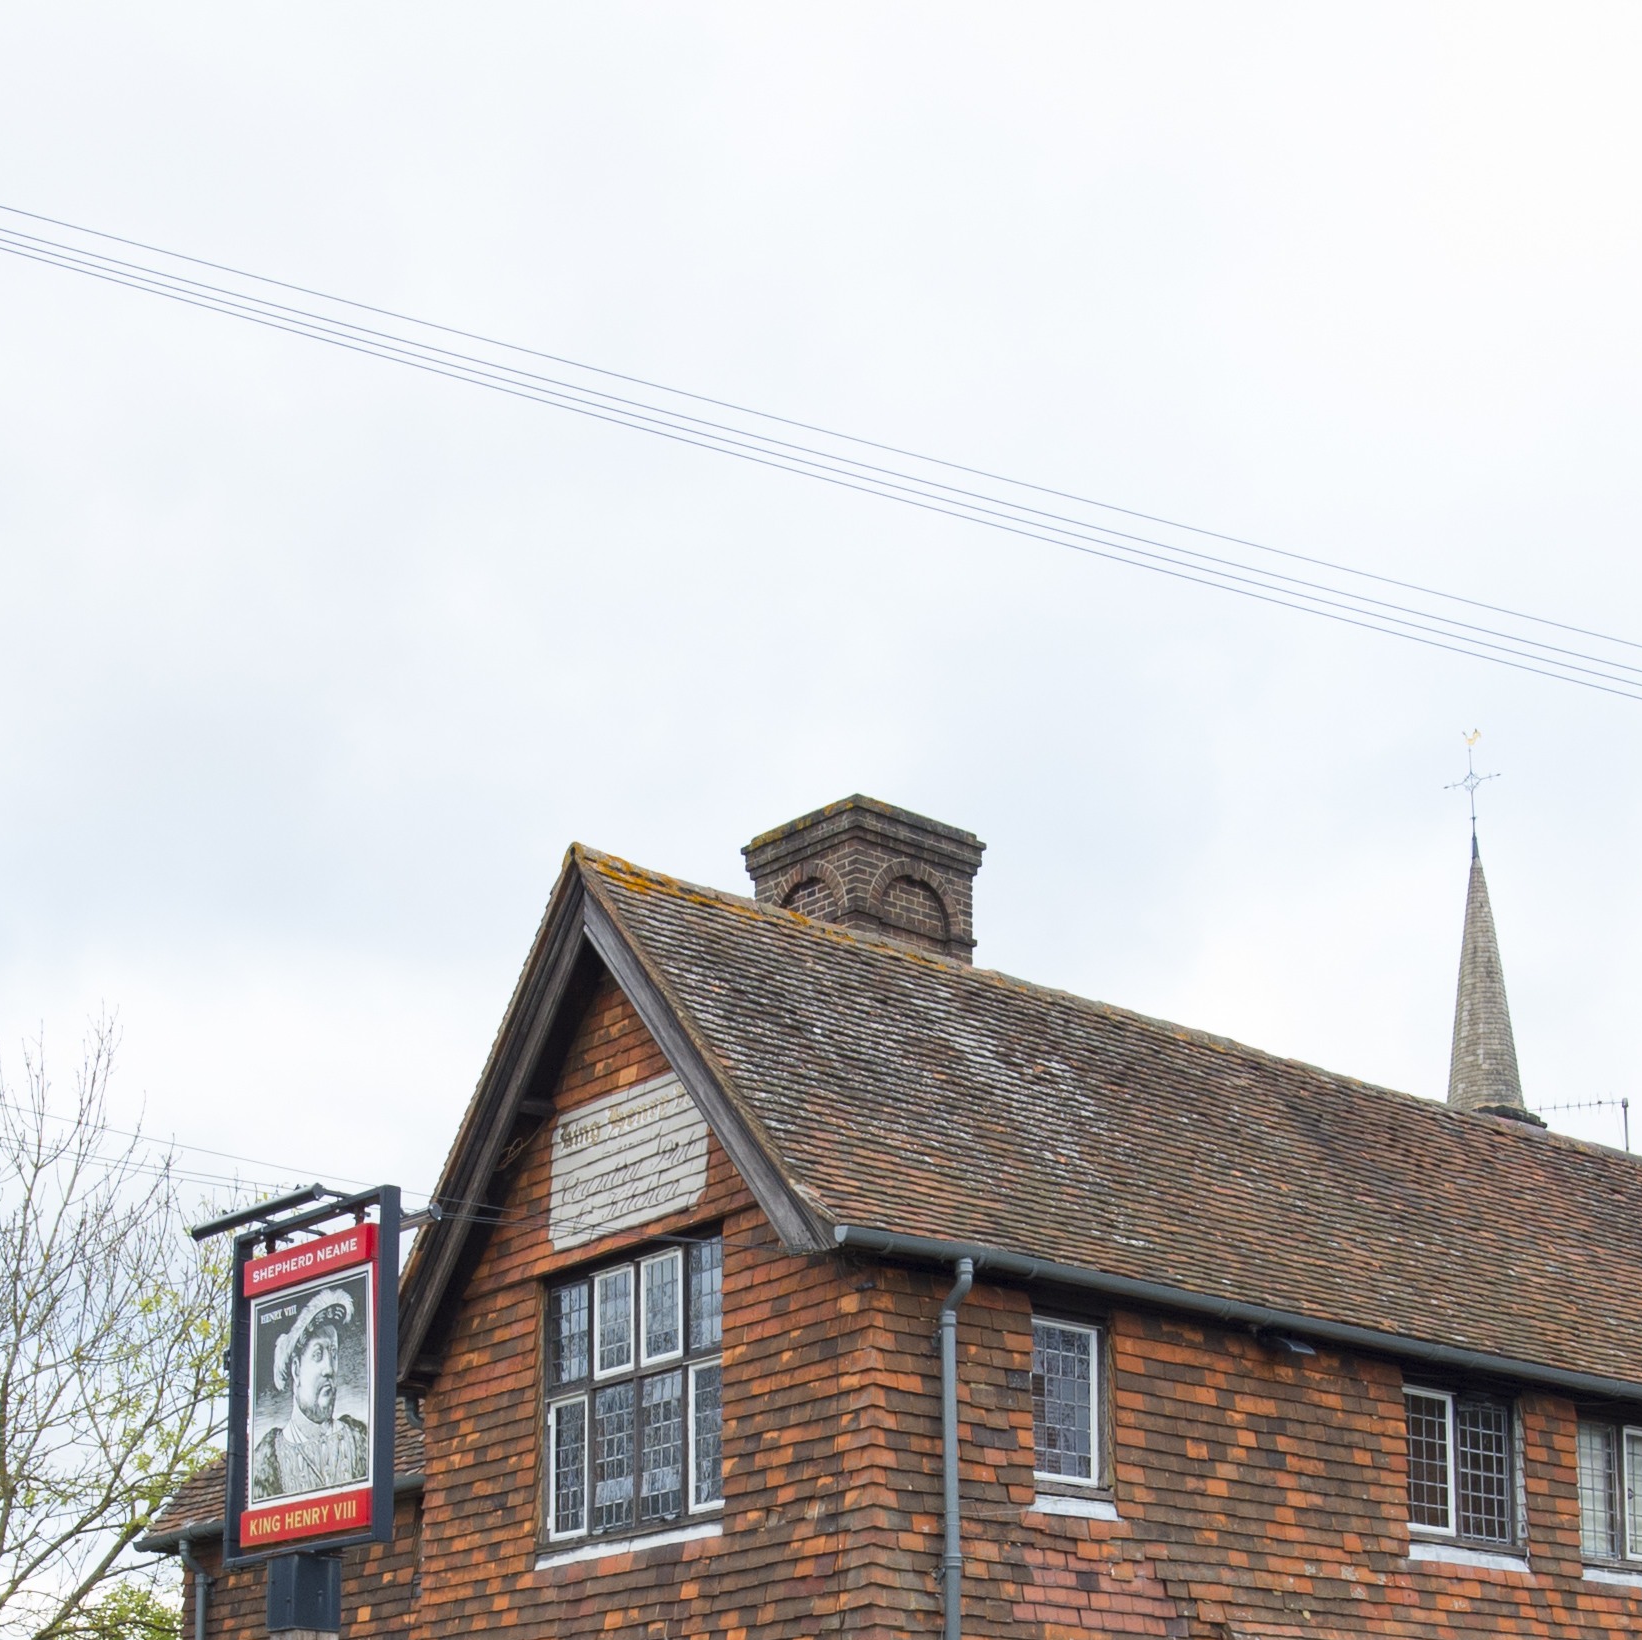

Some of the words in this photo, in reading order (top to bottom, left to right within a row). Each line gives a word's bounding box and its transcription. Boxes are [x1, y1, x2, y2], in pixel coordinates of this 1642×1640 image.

[651, 1130, 697, 1171] Pub
[602, 1180, 680, 1220] Kitchen
[252, 1253, 314, 1284] SHEPHERD
[317, 1238, 358, 1261] NEAME
[249, 1512, 281, 1537] KING
[285, 1505, 329, 1530] HENRY
[333, 1500, 357, 1520] VIII
